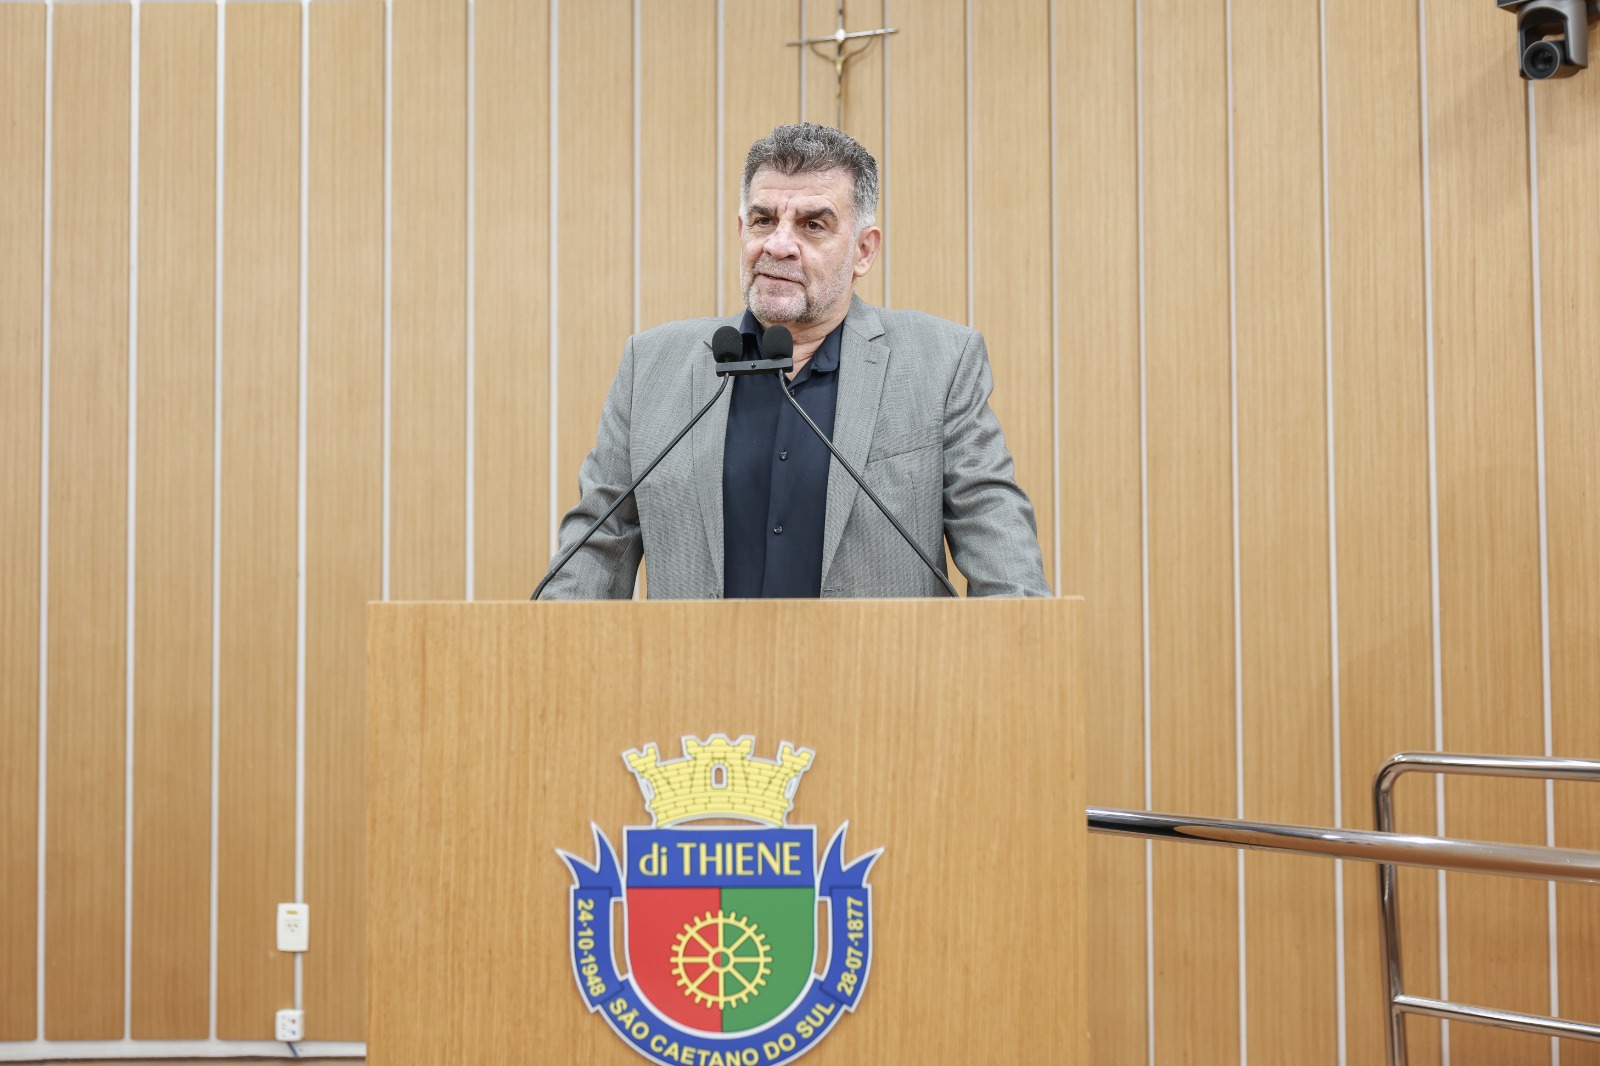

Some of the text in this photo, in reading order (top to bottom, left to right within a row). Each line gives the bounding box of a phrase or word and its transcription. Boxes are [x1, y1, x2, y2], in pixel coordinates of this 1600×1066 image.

[639, 841, 802, 876] di THIENE
[609, 997, 835, 1066] SÃO CAETANO DO SUL
